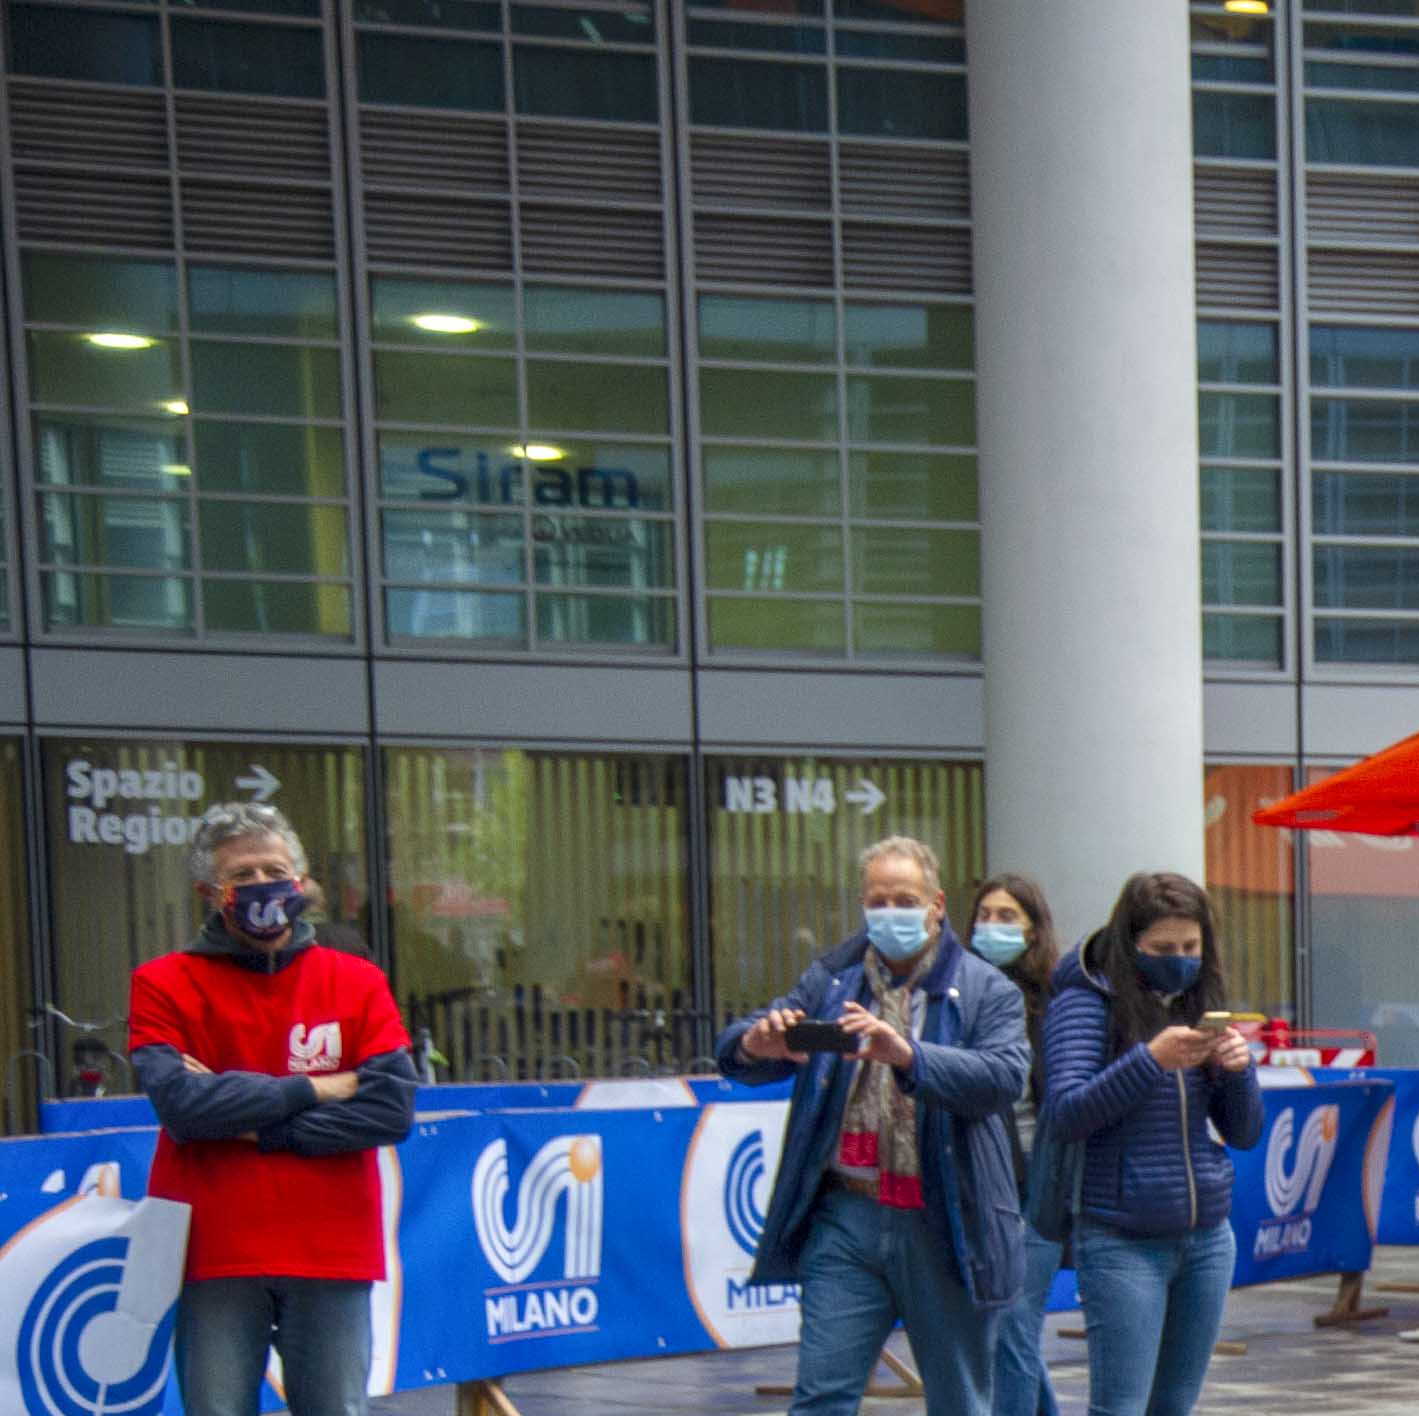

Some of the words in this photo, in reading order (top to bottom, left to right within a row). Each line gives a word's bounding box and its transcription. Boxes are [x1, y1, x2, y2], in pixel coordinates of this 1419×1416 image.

[417, 447, 639, 507] Siram
[66, 760, 205, 808] Spazio
[725, 776, 776, 813] N3
[784, 776, 837, 814] N4
[68, 805, 202, 854] Regio
[1253, 1217, 1313, 1254] MILANO
[485, 1287, 598, 1337] MILANO
[726, 1276, 801, 1309] MILA
